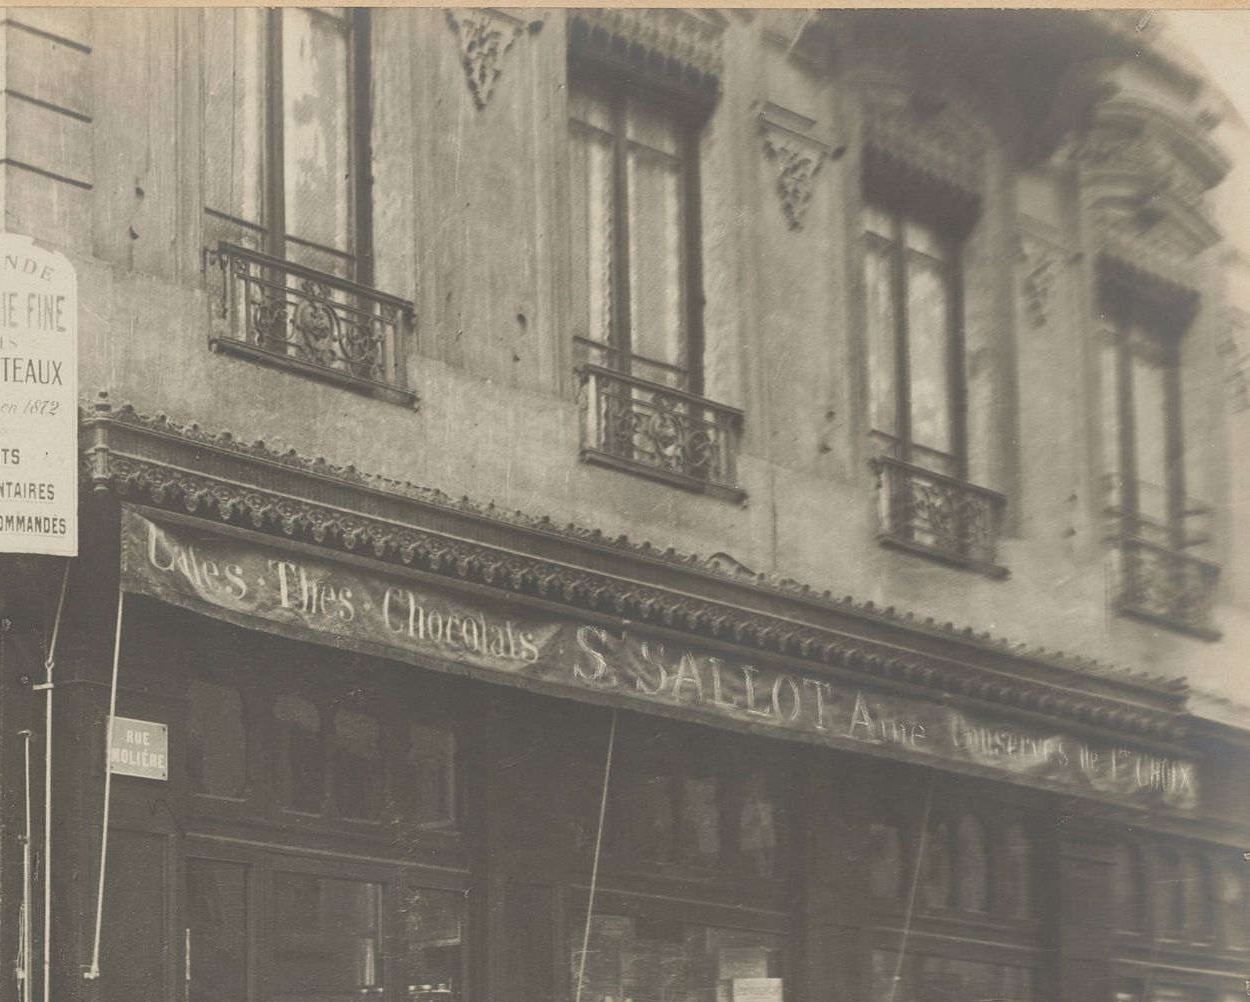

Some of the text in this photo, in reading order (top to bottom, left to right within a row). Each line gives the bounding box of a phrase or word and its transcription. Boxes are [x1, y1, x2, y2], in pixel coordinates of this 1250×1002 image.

[27, 292, 67, 332] FINE
[0, 402, 17, 415] en
[23, 399, 60, 416] 1872
[382, 585, 540, 663] Chocolats
[635, 641, 831, 731] SALLOT
[126, 730, 150, 746] RUE
